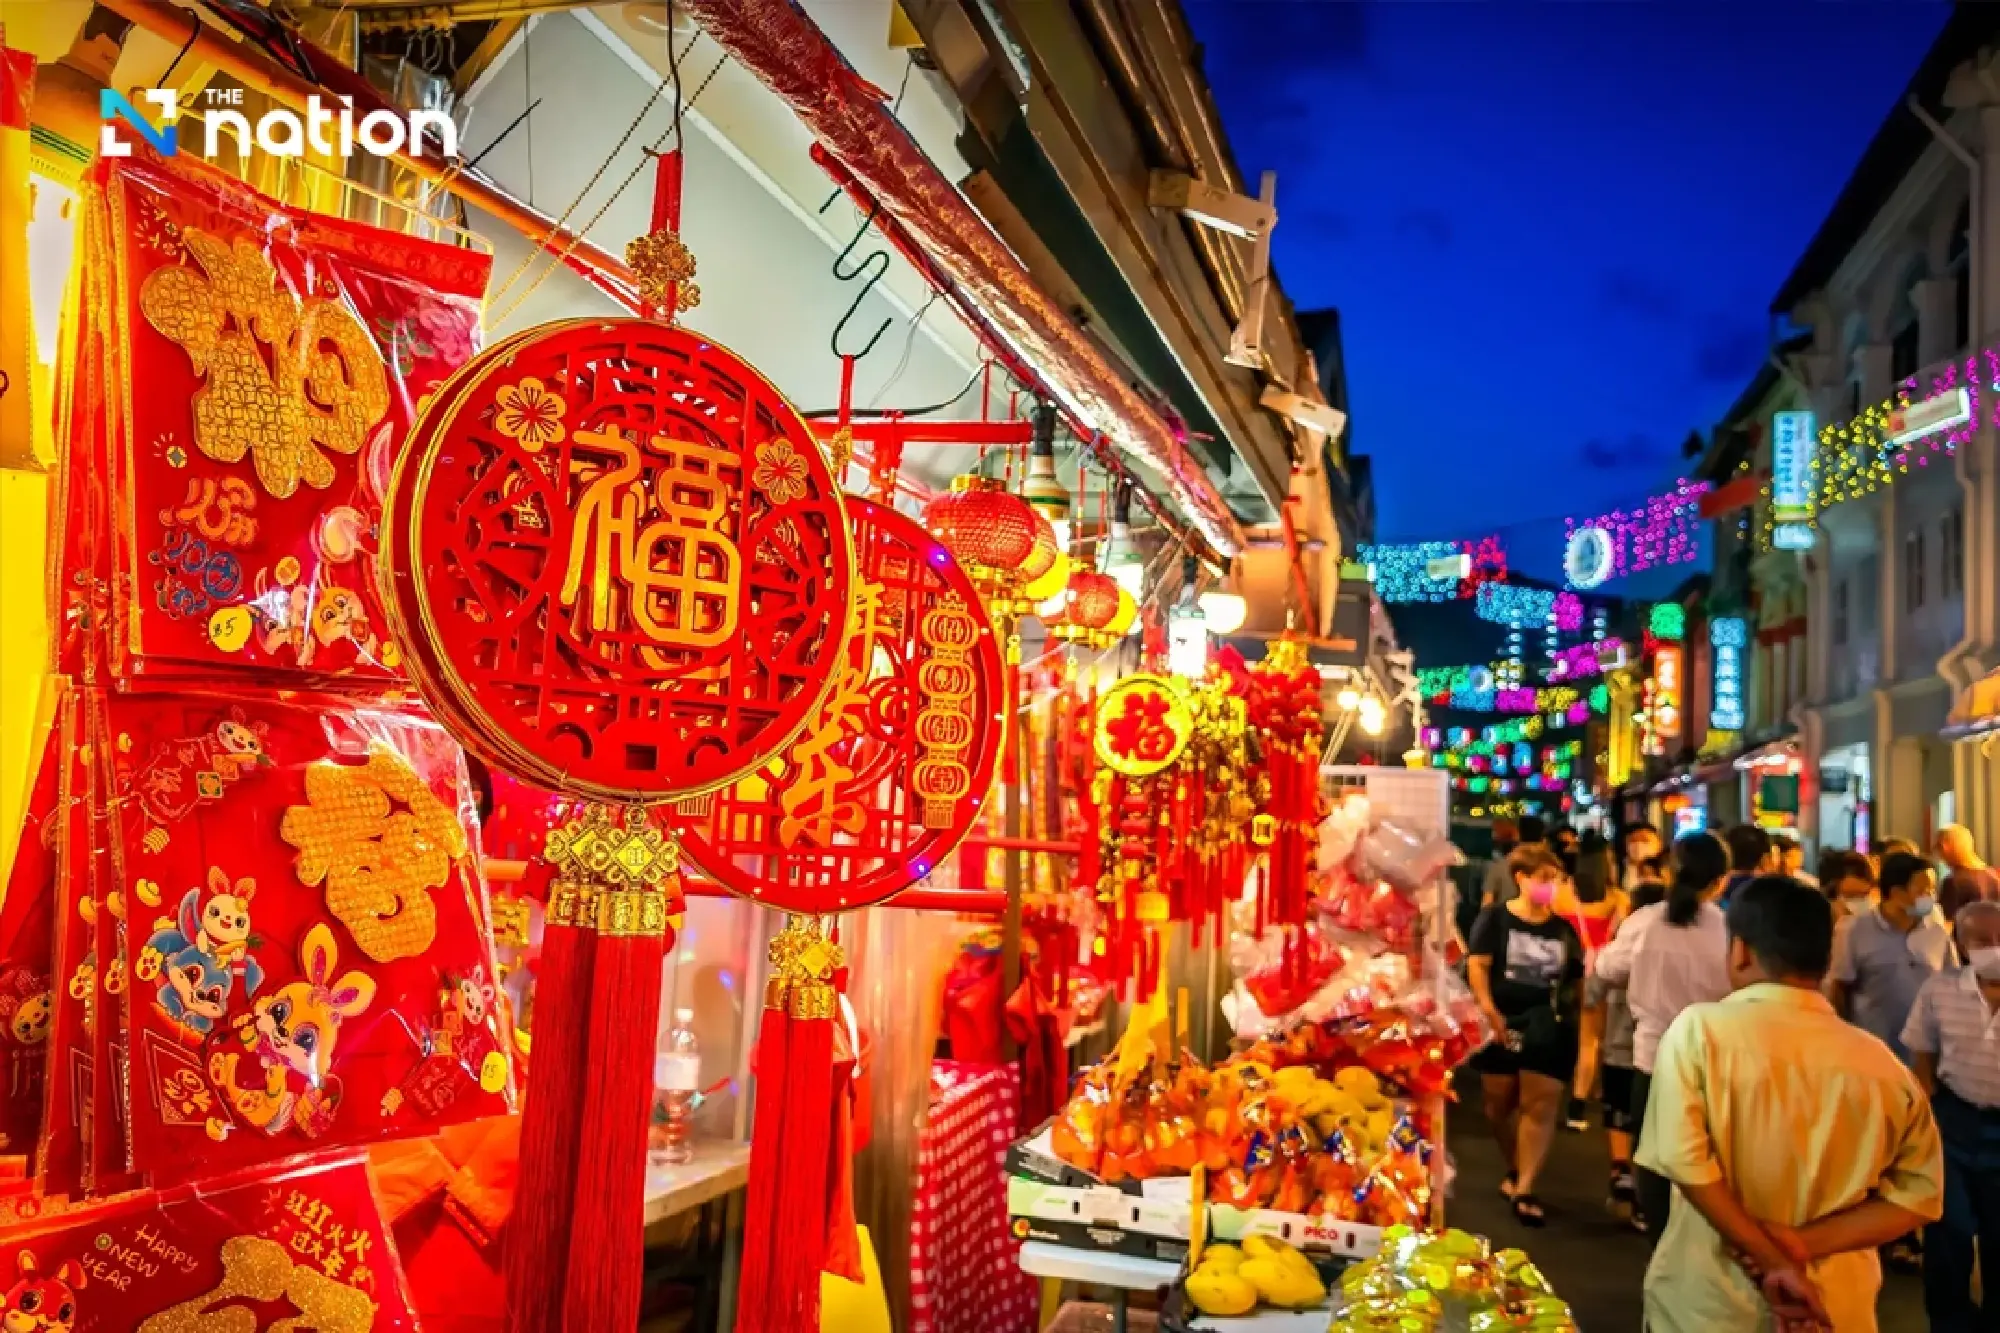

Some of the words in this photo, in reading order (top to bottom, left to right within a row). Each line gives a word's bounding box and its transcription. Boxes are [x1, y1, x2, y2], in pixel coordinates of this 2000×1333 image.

[561, 426, 741, 648] 福
[1106, 691, 1177, 762] 福
[134, 1223, 199, 1273] HAPPY
[1303, 1225, 1340, 1241] PICO
[82, 1252, 132, 1292] YEAR
[108, 1243, 160, 1278] NEW
